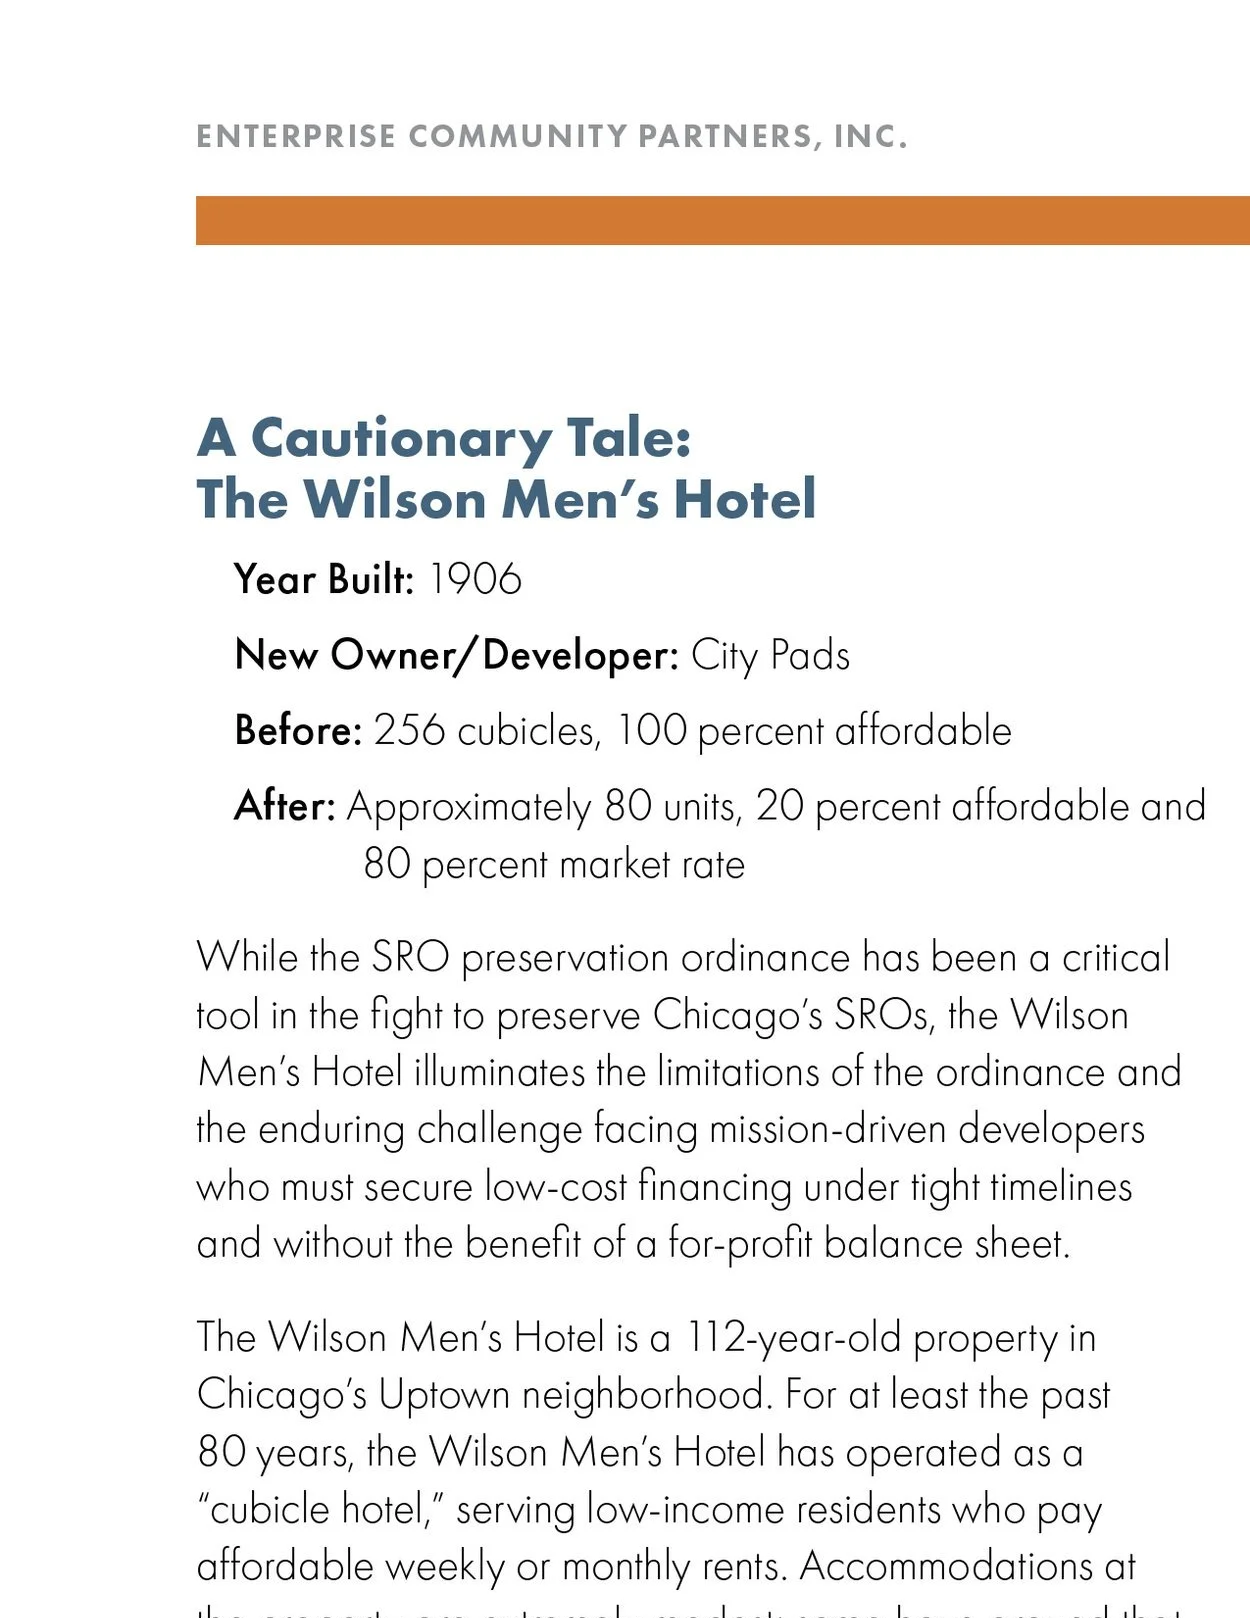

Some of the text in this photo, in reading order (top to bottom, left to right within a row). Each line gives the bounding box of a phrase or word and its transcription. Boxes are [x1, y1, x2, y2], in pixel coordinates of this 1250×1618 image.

[198, 124, 906, 151] ENTERPRISE COMMUNITY PARTNERS, INC.
[197, 414, 689, 469] A Cautionary Tale:
[197, 475, 814, 519] The Wilson Men’s Hotel
[233, 561, 521, 594] Year Built: 1906
[237, 634, 849, 680] New Owner/Developer: City Pads
[237, 711, 1011, 755] Before: 256 cubicles, 100 percent affordable
[233, 786, 1204, 831] After: Approximately 80 units, 20 percent affordable and
[365, 845, 744, 888] 80 percent market rate
[197, 938, 1168, 981] While the SRO preservation ordinance has been a critical
[197, 1318, 1094, 1362] The Wilson Men’s Hotel is a 112-year-old property in
